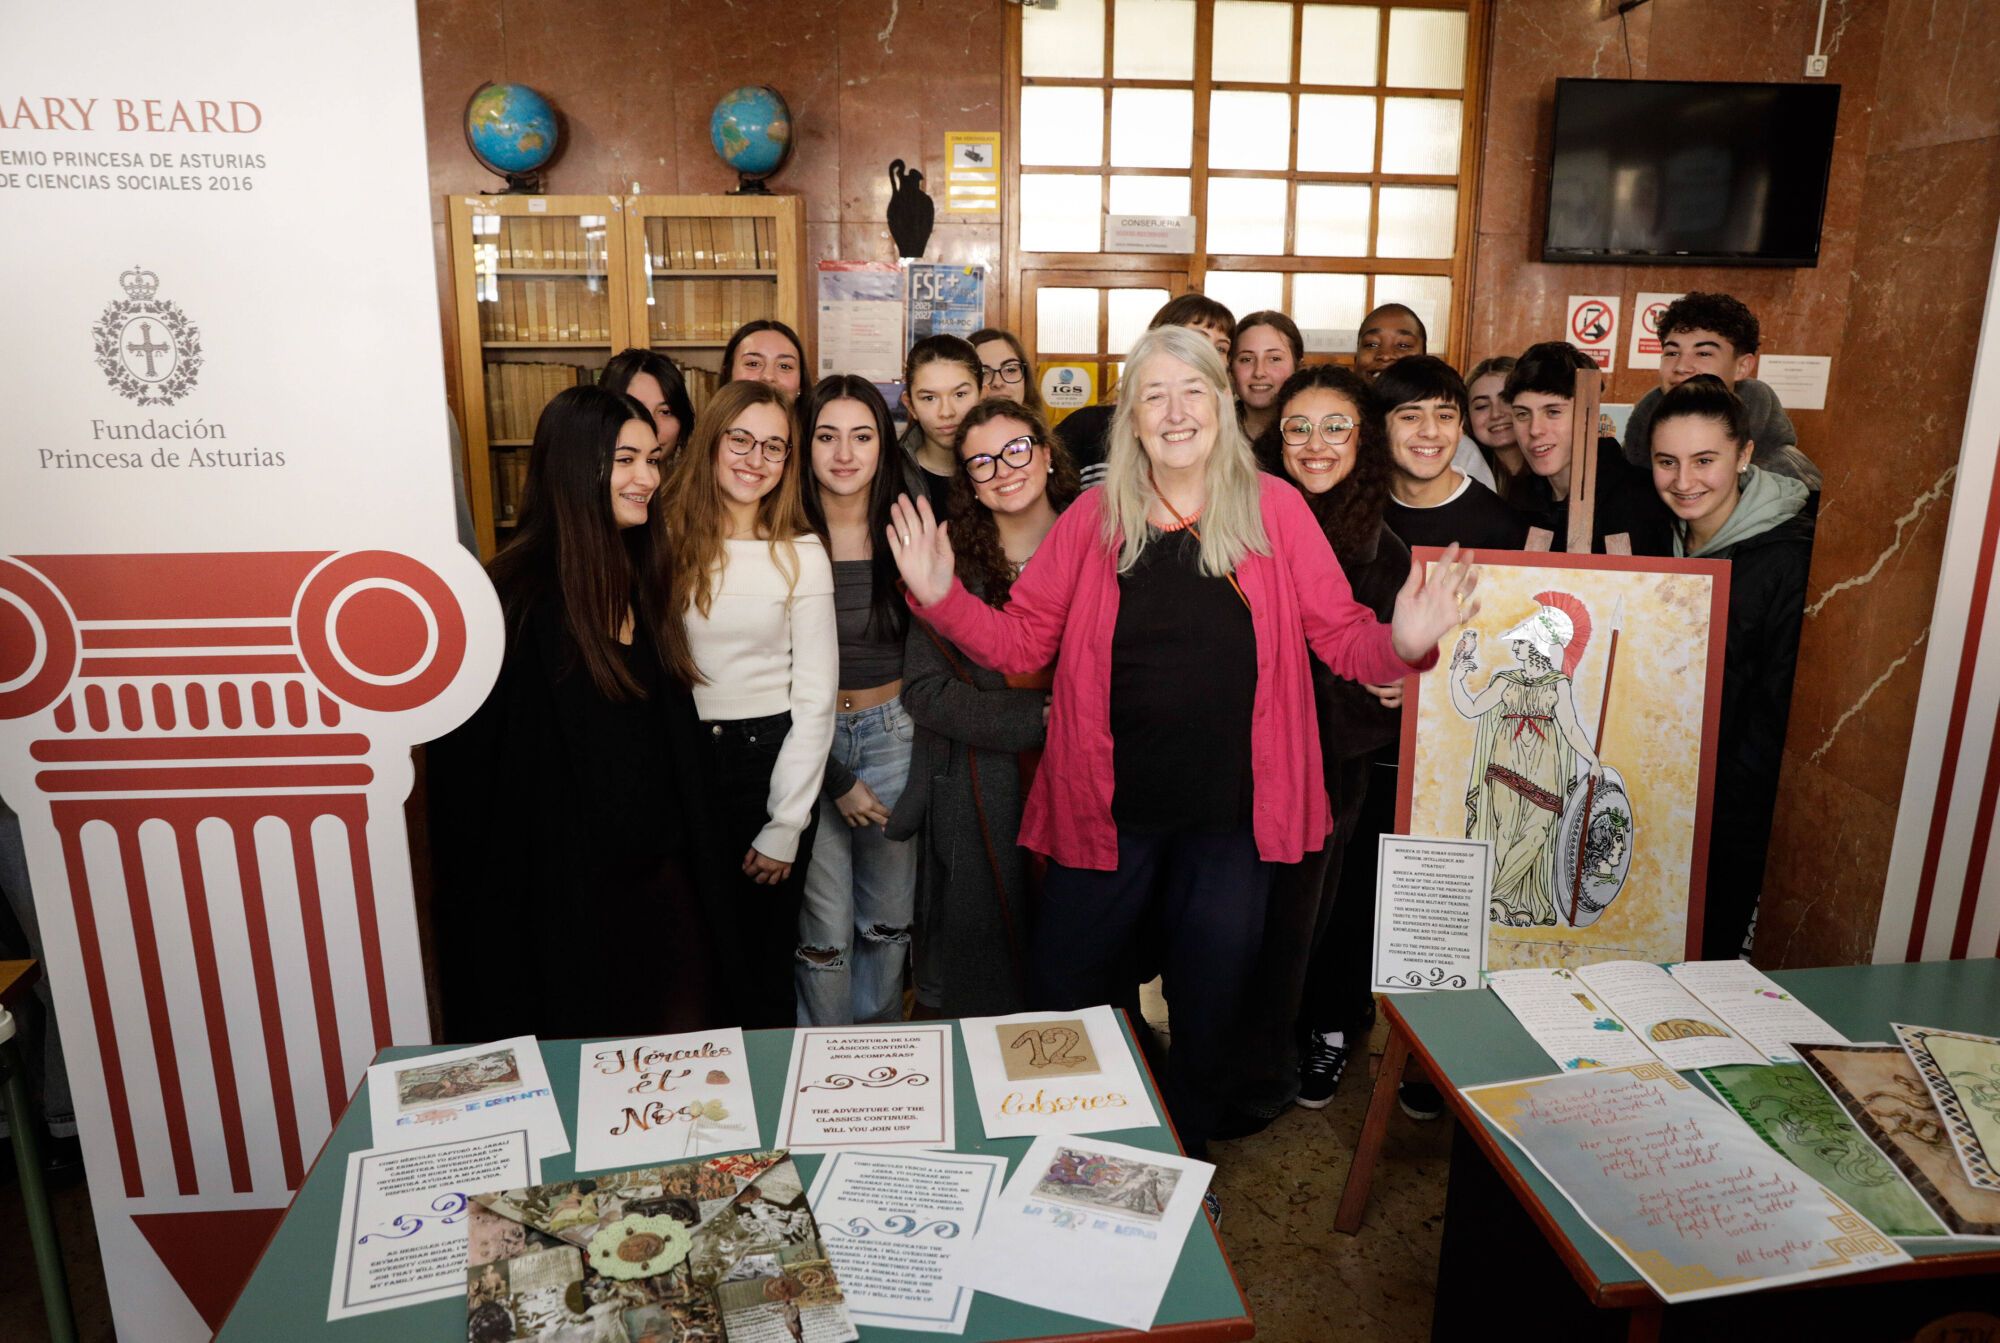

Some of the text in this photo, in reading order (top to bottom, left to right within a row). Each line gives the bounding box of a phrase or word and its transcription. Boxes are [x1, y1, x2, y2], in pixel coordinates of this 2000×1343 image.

[113, 99, 263, 134] BEARD
[53, 151, 144, 168] PRINCESA
[150, 152, 174, 168] DE
[180, 153, 267, 169] ASTURIAS
[0, 173, 253, 191] DE CIENCIAS SOCIALES 2016
[1052, 385, 1083, 393] IGS
[91, 419, 226, 440] Fundación
[39, 448, 287, 469] Princesa de Asturias
[1011, 1028, 1087, 1068] 12
[1716, 1166, 1756, 1184] would
[1758, 1172, 1782, 1188] and
[1758, 1181, 1799, 1199] would
[1754, 1200, 1794, 1214] better
[1736, 1248, 1754, 1266] All
